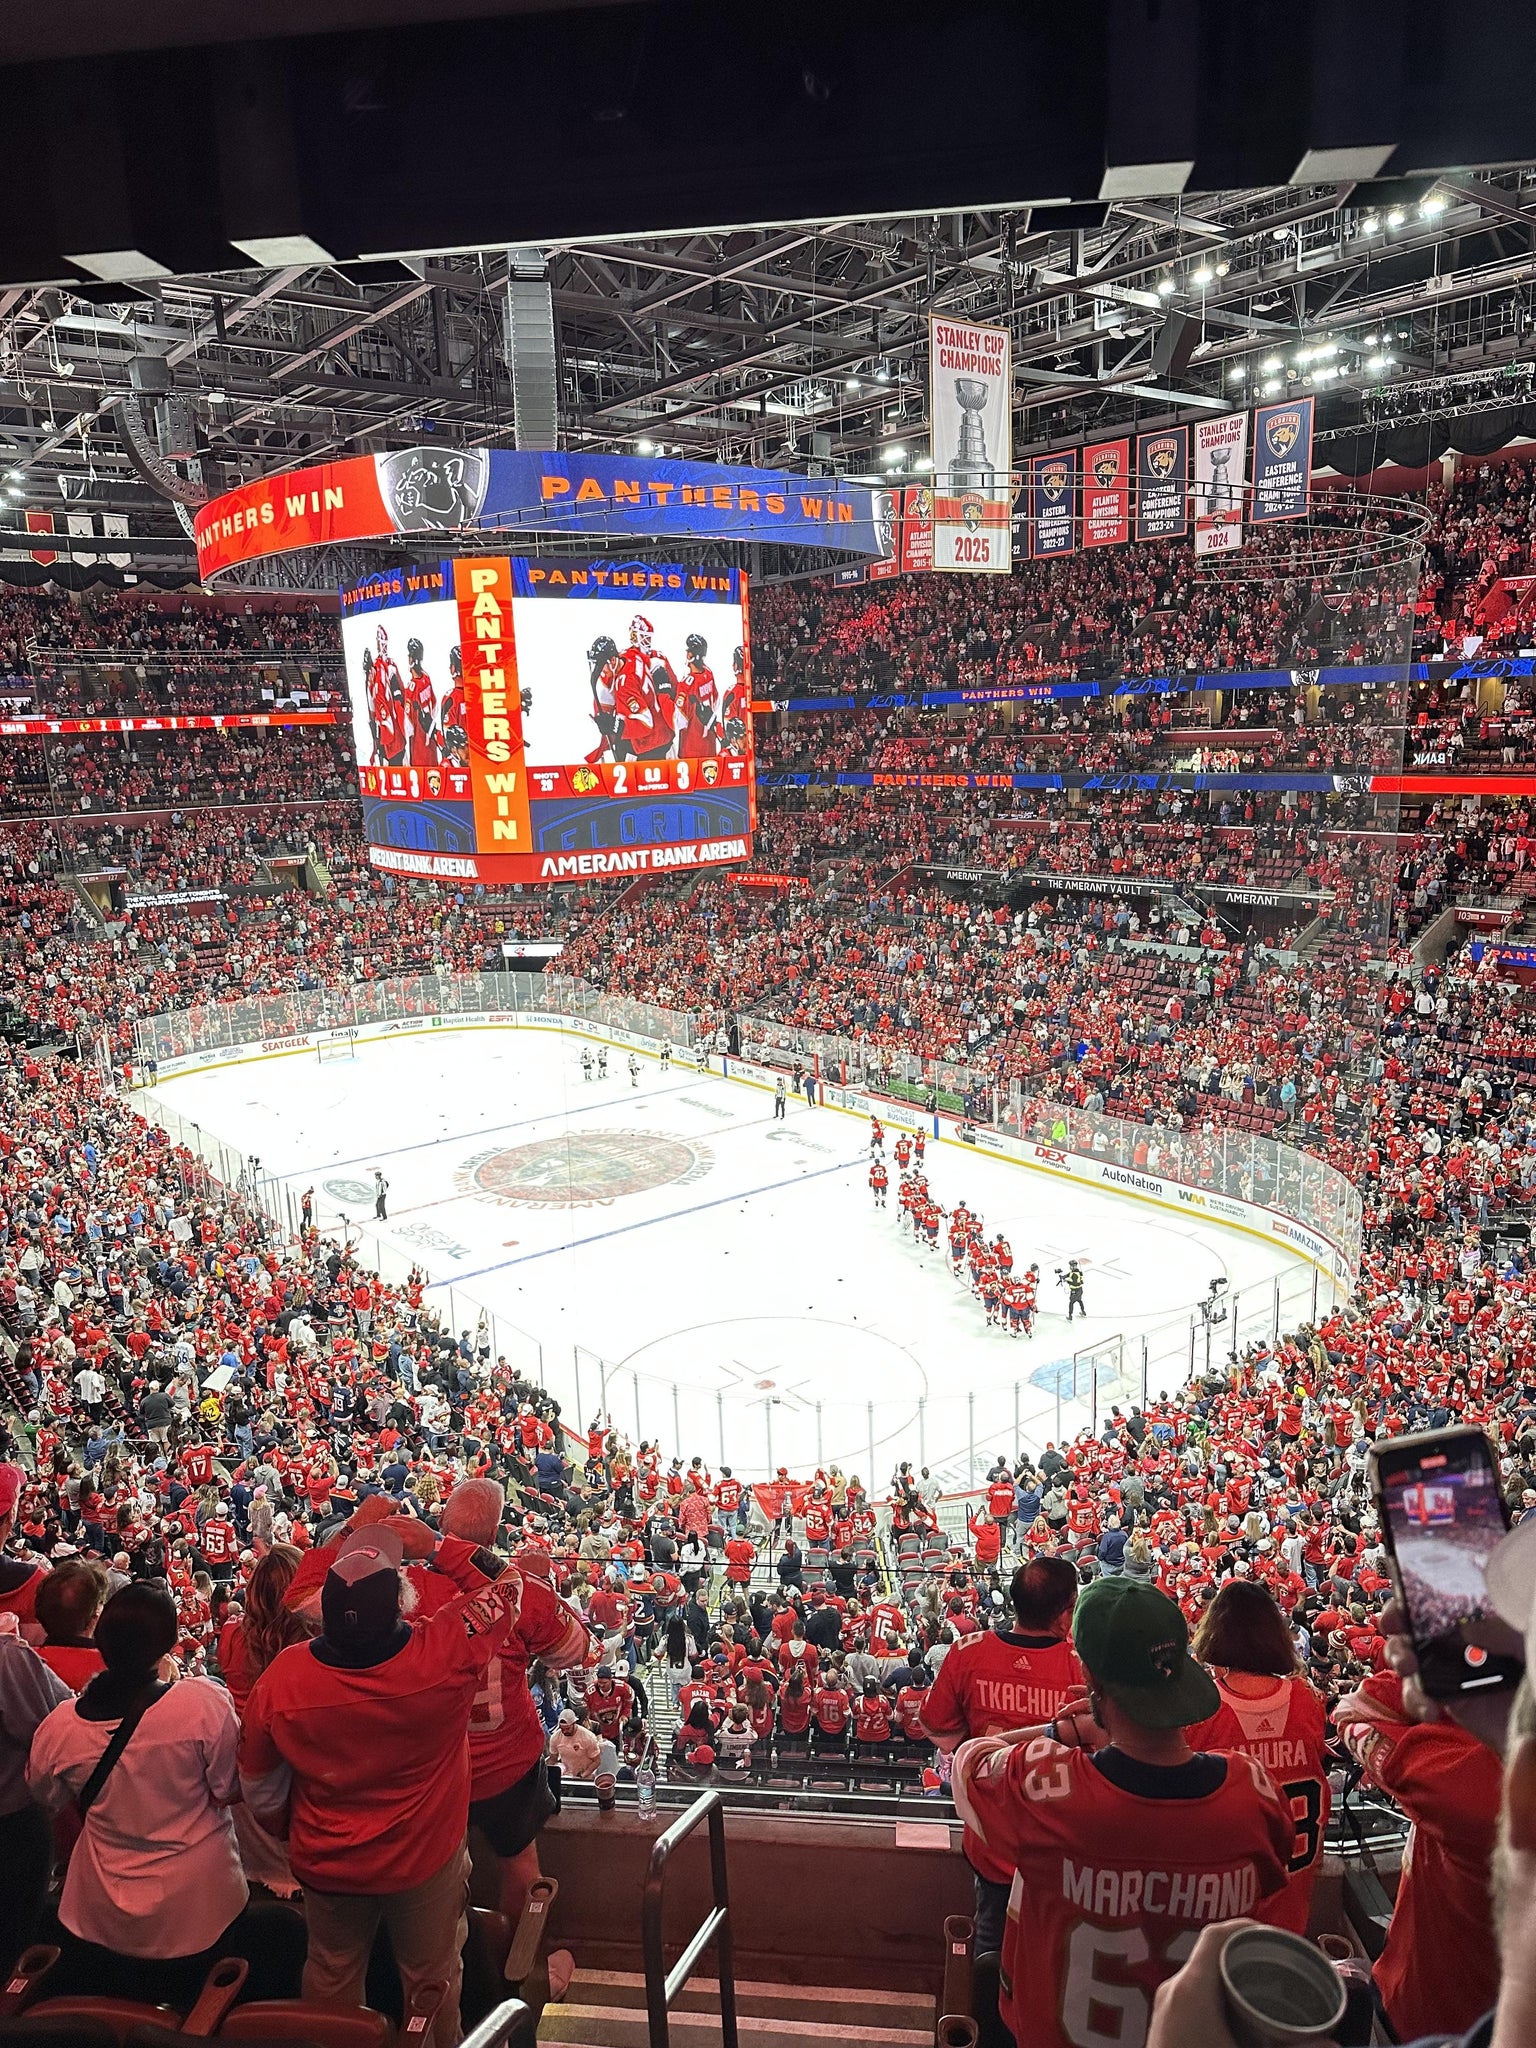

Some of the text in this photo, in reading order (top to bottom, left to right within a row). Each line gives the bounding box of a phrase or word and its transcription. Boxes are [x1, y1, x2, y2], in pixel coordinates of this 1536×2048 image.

[937, 325, 1004, 353] STANLEY CUP
[940, 348, 1001, 376] CHAMPIONS
[1200, 419, 1243, 437] STANLEY CUP
[1201, 431, 1240, 448] CHAMPIONS
[1265, 462, 1296, 476] EASTERN
[1259, 473, 1303, 488] CONFERENCE
[542, 476, 853, 523] PANTHERS WIN
[1092, 494, 1119, 507] ATLANTIC
[1142, 495, 1181, 510] CONFERENCE
[197, 486, 343, 550] PANTHERS WIN
[1043, 505, 1066, 517] EASTERN
[1093, 506, 1118, 518] DIVISION
[1039, 527, 1069, 539] CHAMPIONS
[1093, 528, 1117, 539] 2023-24
[1148, 521, 1174, 531] 2023-24
[1043, 538, 1064, 549] 2022-23
[1208, 532, 1228, 548] 2024
[955, 537, 989, 562] 2025
[530, 570, 730, 591] PANTHERS WIN
[343, 573, 442, 605] PANTHERS WIN
[962, 687, 1052, 699] PANTHERS WIN
[471, 568, 517, 840] PANTHERS WIN
[379, 769, 387, 796] 2
[613, 765, 627, 794] 2
[677, 762, 689, 789] 3
[873, 774, 1012, 787] PANTHERS WIN
[410, 770, 420, 797] 3
[402, 853, 433, 875] BANK
[434, 858, 478, 878] ARENA
[541, 840, 746, 877] AMERANT BANK ARENA
[947, 871, 982, 881] AMERANT
[1049, 879, 1142, 896] THE AMERANT VAULT
[1226, 893, 1280, 906] AMERANT
[1458, 912, 1471, 920] 103
[1501, 915, 1510, 923] 10
[443, 1016, 464, 1024] Baptist
[331, 1028, 359, 1038] finally
[262, 1036, 309, 1052] SEATGEEK
[887, 1105, 915, 1117] COMCAST
[888, 1112, 916, 1126] BUSINESS
[1034, 1147, 1068, 1164] DEX
[1042, 1159, 1071, 1172] imaging
[875, 1171, 884, 1179] 42
[1102, 1167, 1162, 1193] AutoNation
[1178, 1190, 1206, 1206] WM
[1210, 1204, 1247, 1219] SUSTAINABILITY
[1289, 1228, 1322, 1255] AMAZING
[1013, 1292, 1026, 1303] 72
[192, 1460, 206, 1476] 17
[206, 1536, 224, 1554] 63
[876, 1617, 891, 1638] 16
[574, 1677, 586, 1692] 5
[824, 1706, 839, 1721] 16
[863, 1714, 885, 1729] 72
[1063, 1858, 1257, 1919] MARCHAND
